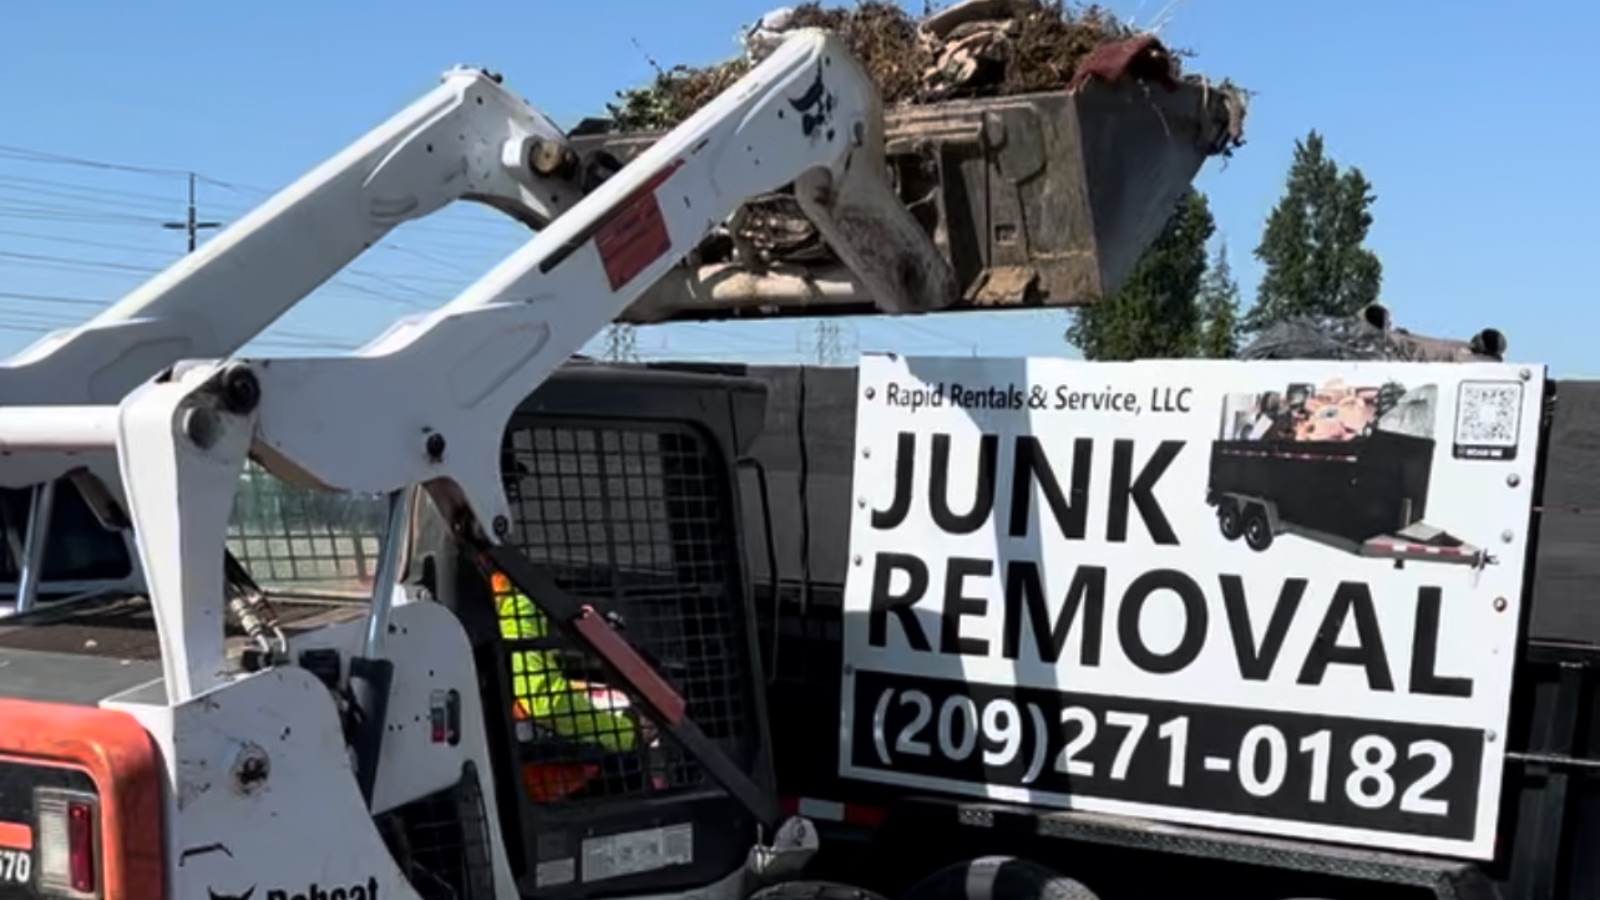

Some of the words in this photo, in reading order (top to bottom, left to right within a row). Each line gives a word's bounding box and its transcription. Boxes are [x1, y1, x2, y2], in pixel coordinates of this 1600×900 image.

[886, 382, 944, 413] Rapid
[950, 383, 1024, 410] Rentals
[1027, 385, 1048, 409] &
[1054, 385, 1142, 415] Service,
[1150, 386, 1192, 413] LLC
[870, 431, 1188, 546] JUNK
[868, 551, 1474, 698] REMOVAL
[0, 850, 31, 883] 70
